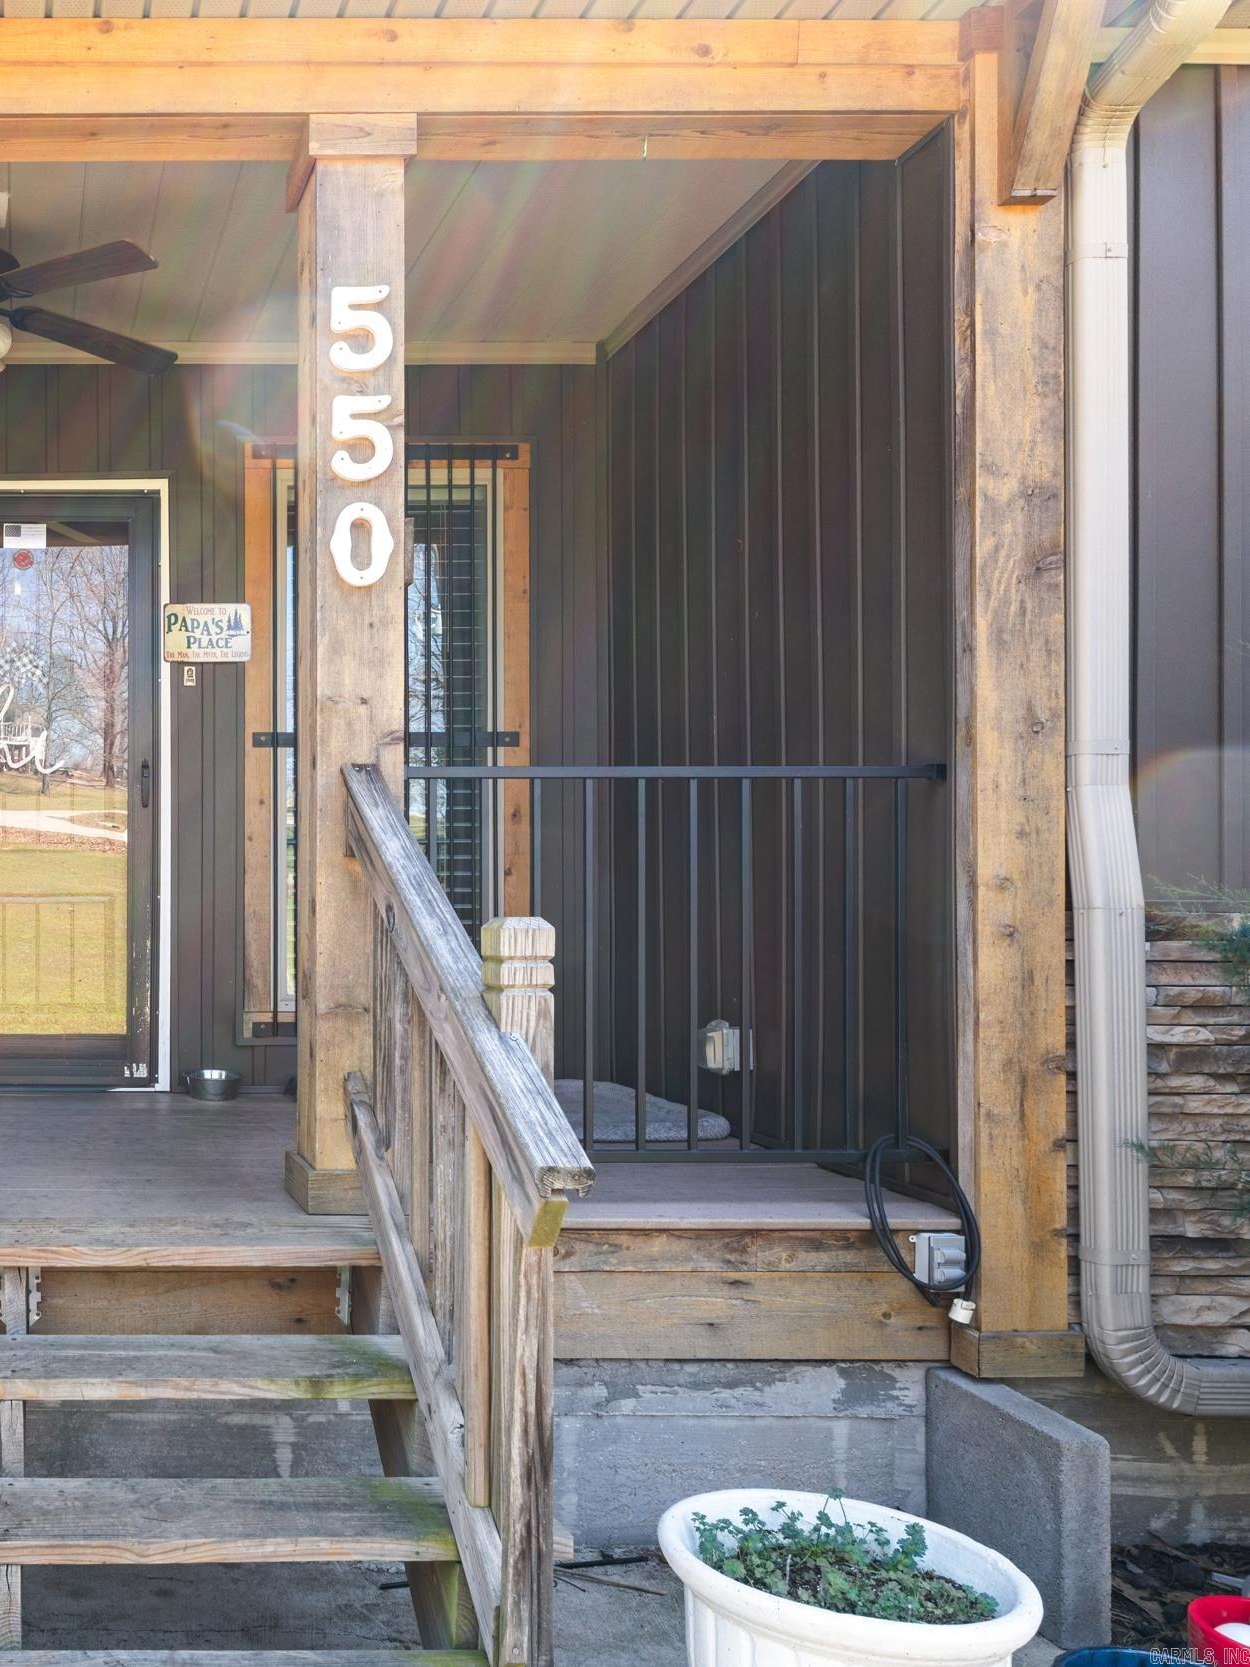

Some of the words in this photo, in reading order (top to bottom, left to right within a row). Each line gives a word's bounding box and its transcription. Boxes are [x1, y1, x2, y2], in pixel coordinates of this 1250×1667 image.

[329, 285, 394, 587] 550
[186, 606, 216, 615] WELCOME
[166, 613, 224, 636] PAPA'S
[186, 635, 233, 649] PLACE
